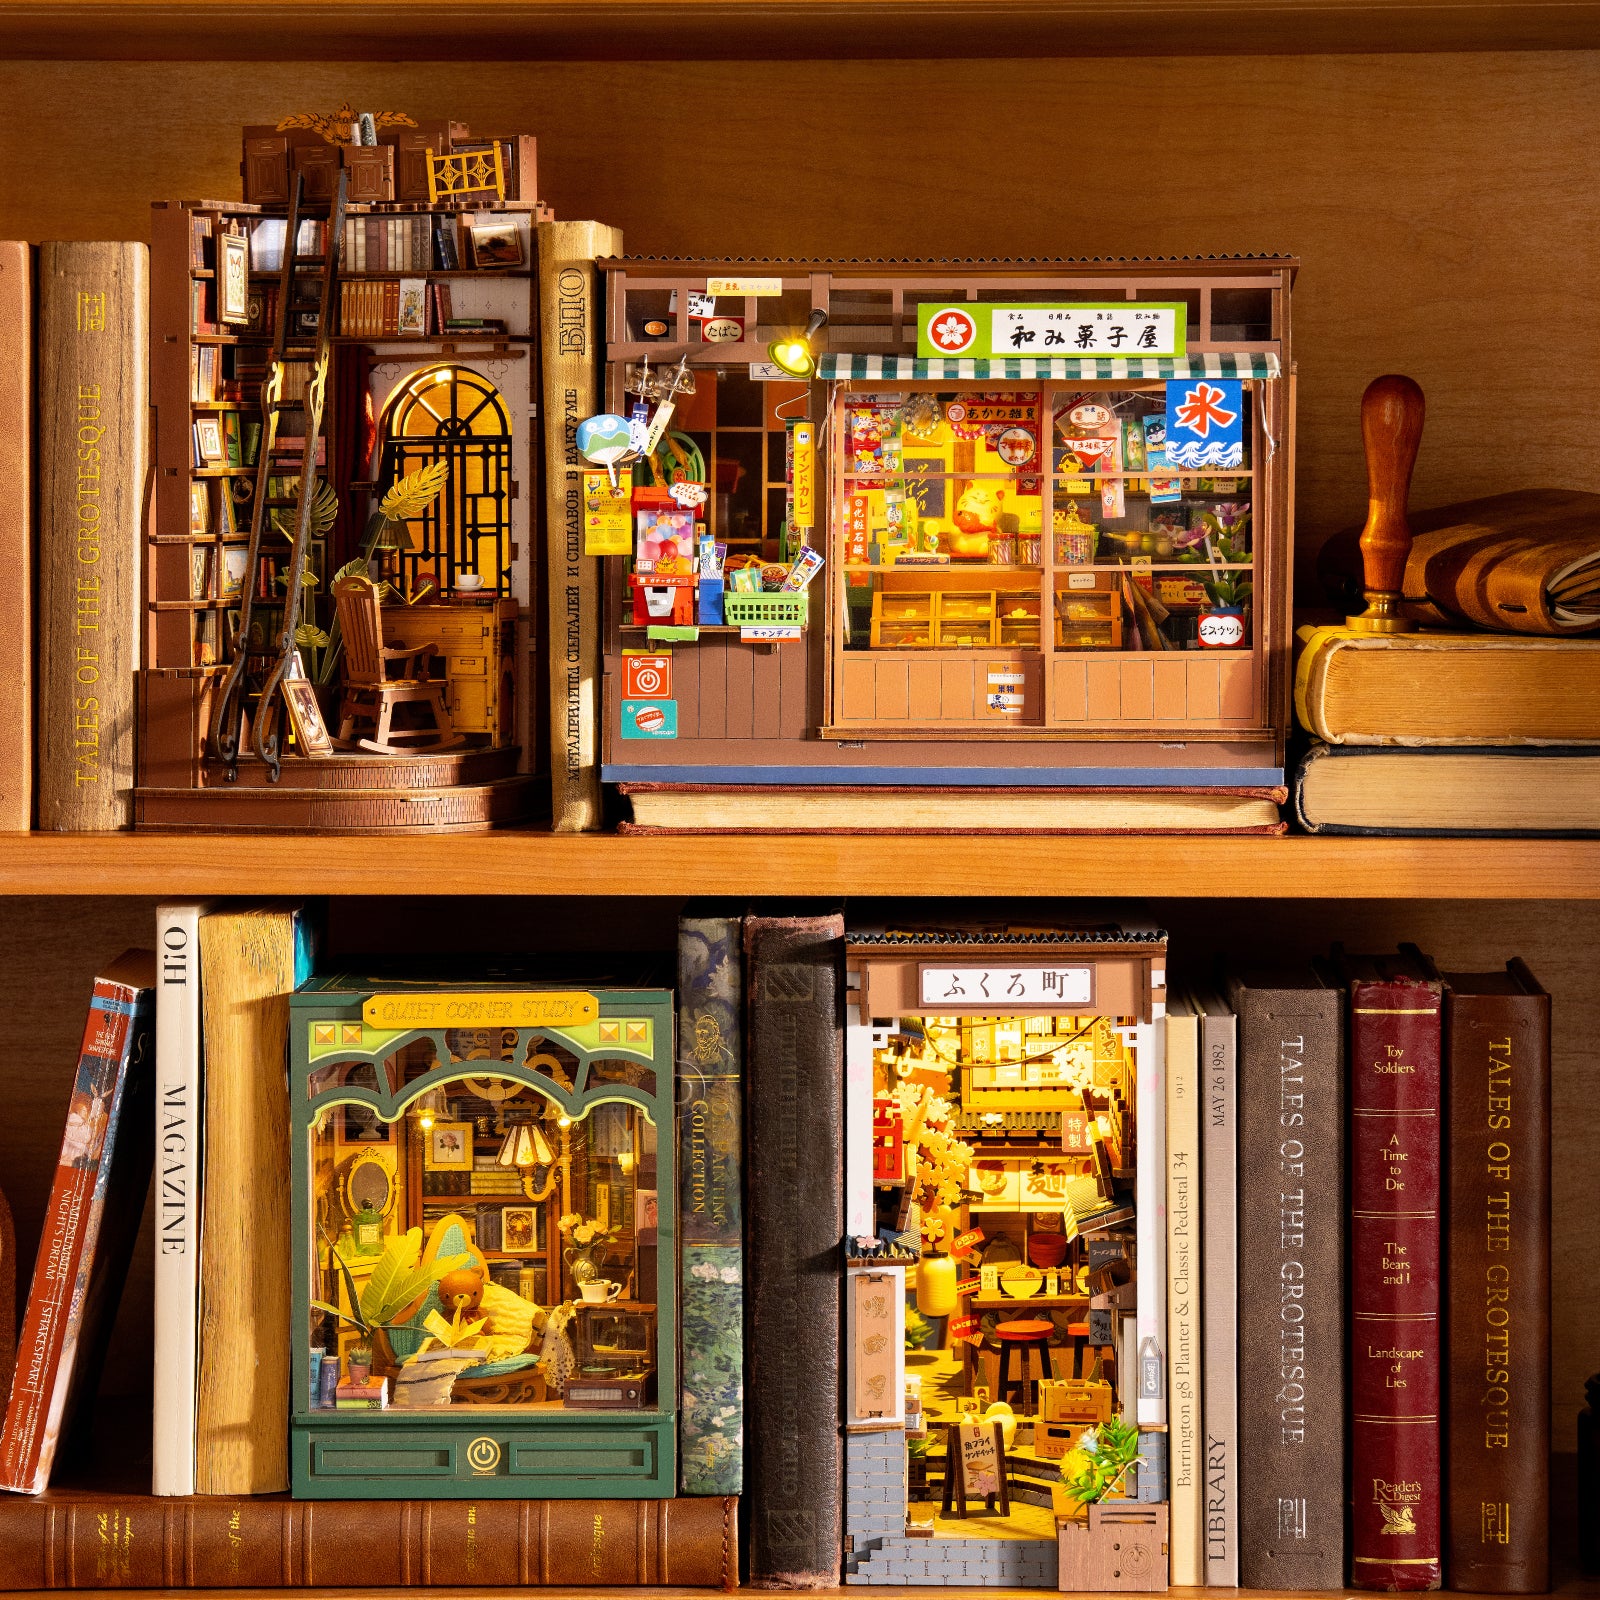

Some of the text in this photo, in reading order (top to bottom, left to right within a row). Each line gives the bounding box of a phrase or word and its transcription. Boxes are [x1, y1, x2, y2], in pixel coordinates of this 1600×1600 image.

[558, 268, 585, 355] БПО
[1009, 324, 1160, 349] 和み菓子屋
[966, 407, 1035, 420] あかり雑貨
[1176, 383, 1236, 436] 氷
[798, 450, 810, 515] インドカレー
[565, 490, 579, 561] СПЛАВОВ
[75, 383, 106, 787] TALES OF THE GROTESQUE
[752, 629, 791, 637] キャンディ
[943, 969, 1070, 1000] ふくろ町
[382, 999, 579, 1021] QUIET CORNER STUDY
[1384, 1045, 1404, 1059] Toy
[1374, 1062, 1416, 1074] Soldiers
[1176, 1076, 1184, 1099] 1912
[1213, 1043, 1225, 1127] MAY 26 1982
[1389, 1133, 1400, 1145] A
[692, 1100, 709, 1215] COLLECTION
[1173, 1151, 1189, 1170] 34
[1380, 1149, 1408, 1161] Time
[162, 1084, 187, 1255] MAGAZINE
[1390, 1165, 1401, 1175] to
[1385, 1178, 1405, 1190] Die
[1173, 1174, 1190, 1237] Pedestal
[45, 1190, 73, 1280] NIGHT'S DREAM
[1276, 1035, 1304, 1444] TALES OF THE GROTESQUE
[1481, 1037, 1512, 1449] TALES OF THE GROTESQUE
[1384, 1242, 1407, 1255] The
[1174, 1241, 1190, 1294] Classic
[1382, 1257, 1411, 1270] Bears
[1383, 1273, 1410, 1284] and I
[1174, 1298, 1190, 1315] &
[26, 1307, 54, 1388] SHAKESPEARE
[1174, 1319, 1190, 1377] Planter
[1368, 1346, 1424, 1360] Landscape
[1390, 1362, 1402, 1373] of
[1386, 1376, 1407, 1388] Lies
[1176, 1402, 1194, 1487] Barrington
[1208, 1435, 1226, 1561] LIBRARY
[1372, 1478, 1421, 1501] Reader's
[1393, 1491, 1421, 1502] Digest
[229, 1509, 240, 1531] the
[228, 1531, 242, 1548] of
